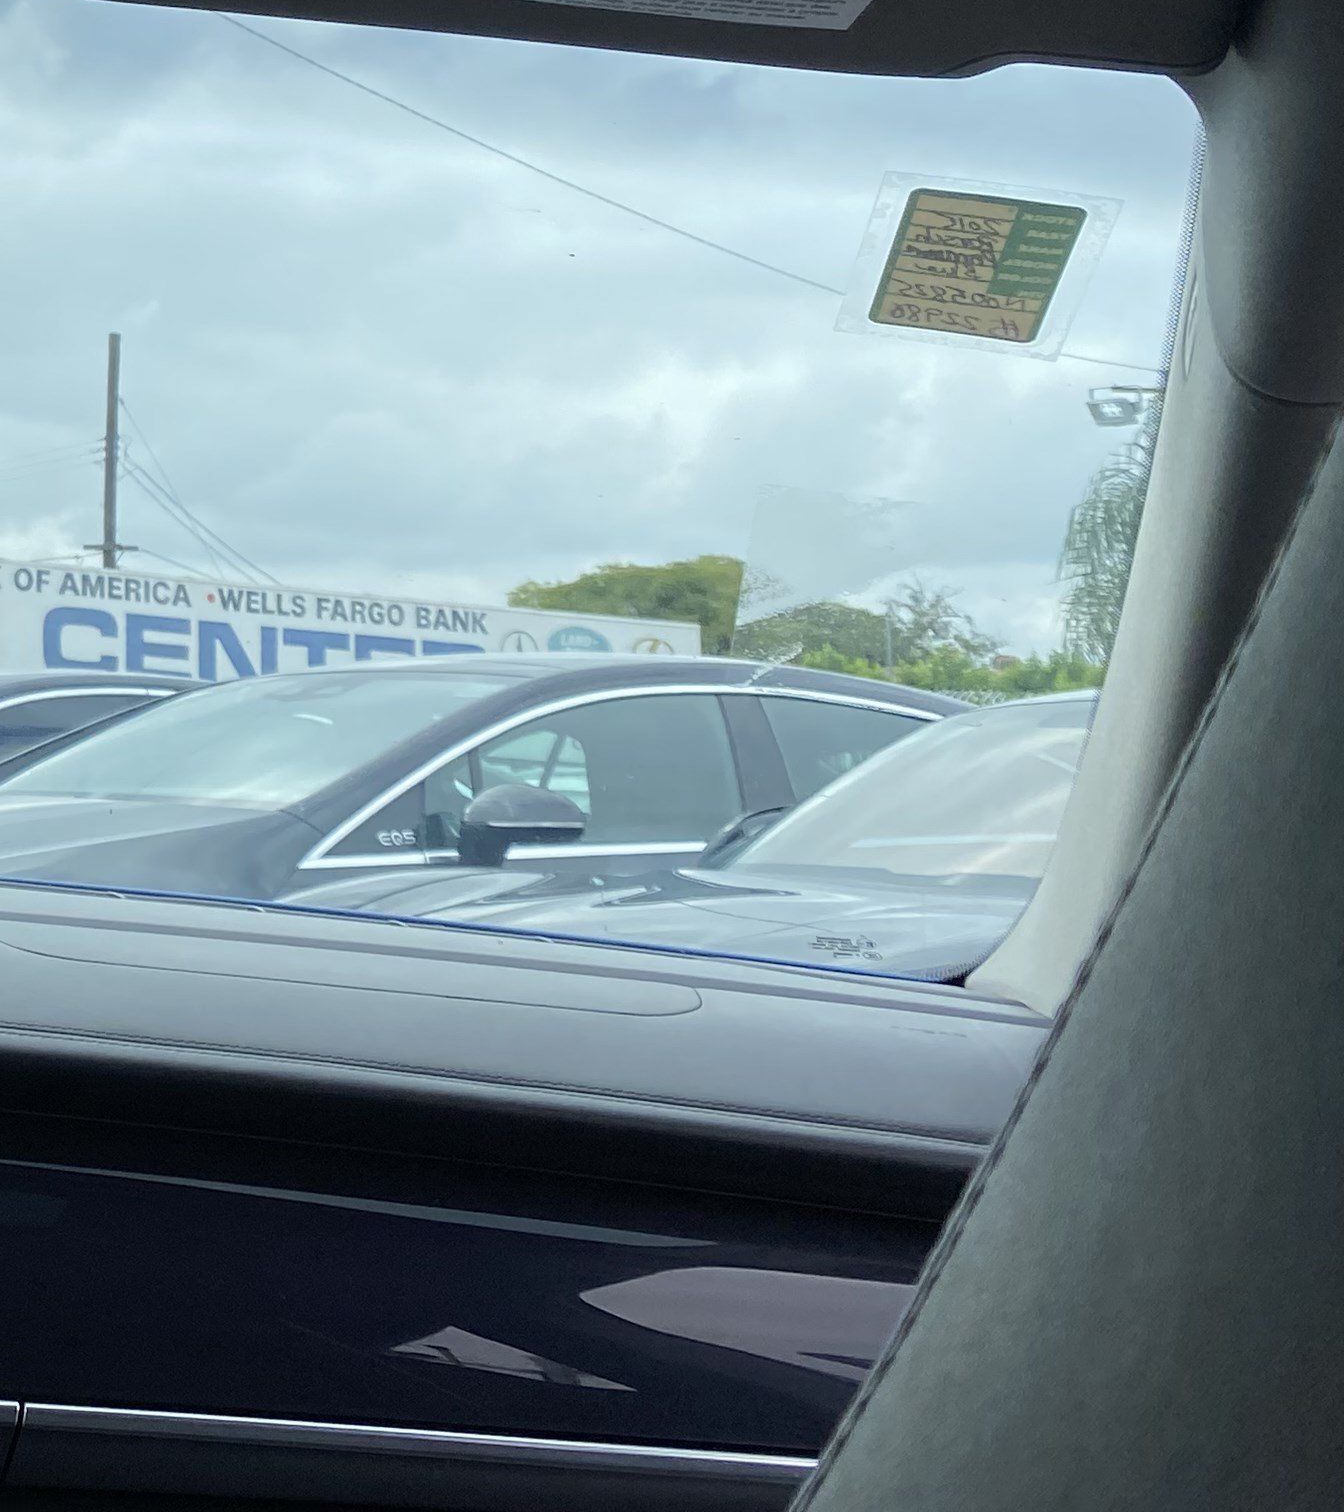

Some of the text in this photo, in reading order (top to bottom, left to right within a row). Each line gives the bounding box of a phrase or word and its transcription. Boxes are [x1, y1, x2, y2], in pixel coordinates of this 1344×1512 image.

[13, 568, 50, 593] OF
[58, 572, 192, 609] AMERICA
[217, 587, 306, 619] WELLS
[315, 596, 405, 628] FARGO
[415, 607, 488, 635] BANK
